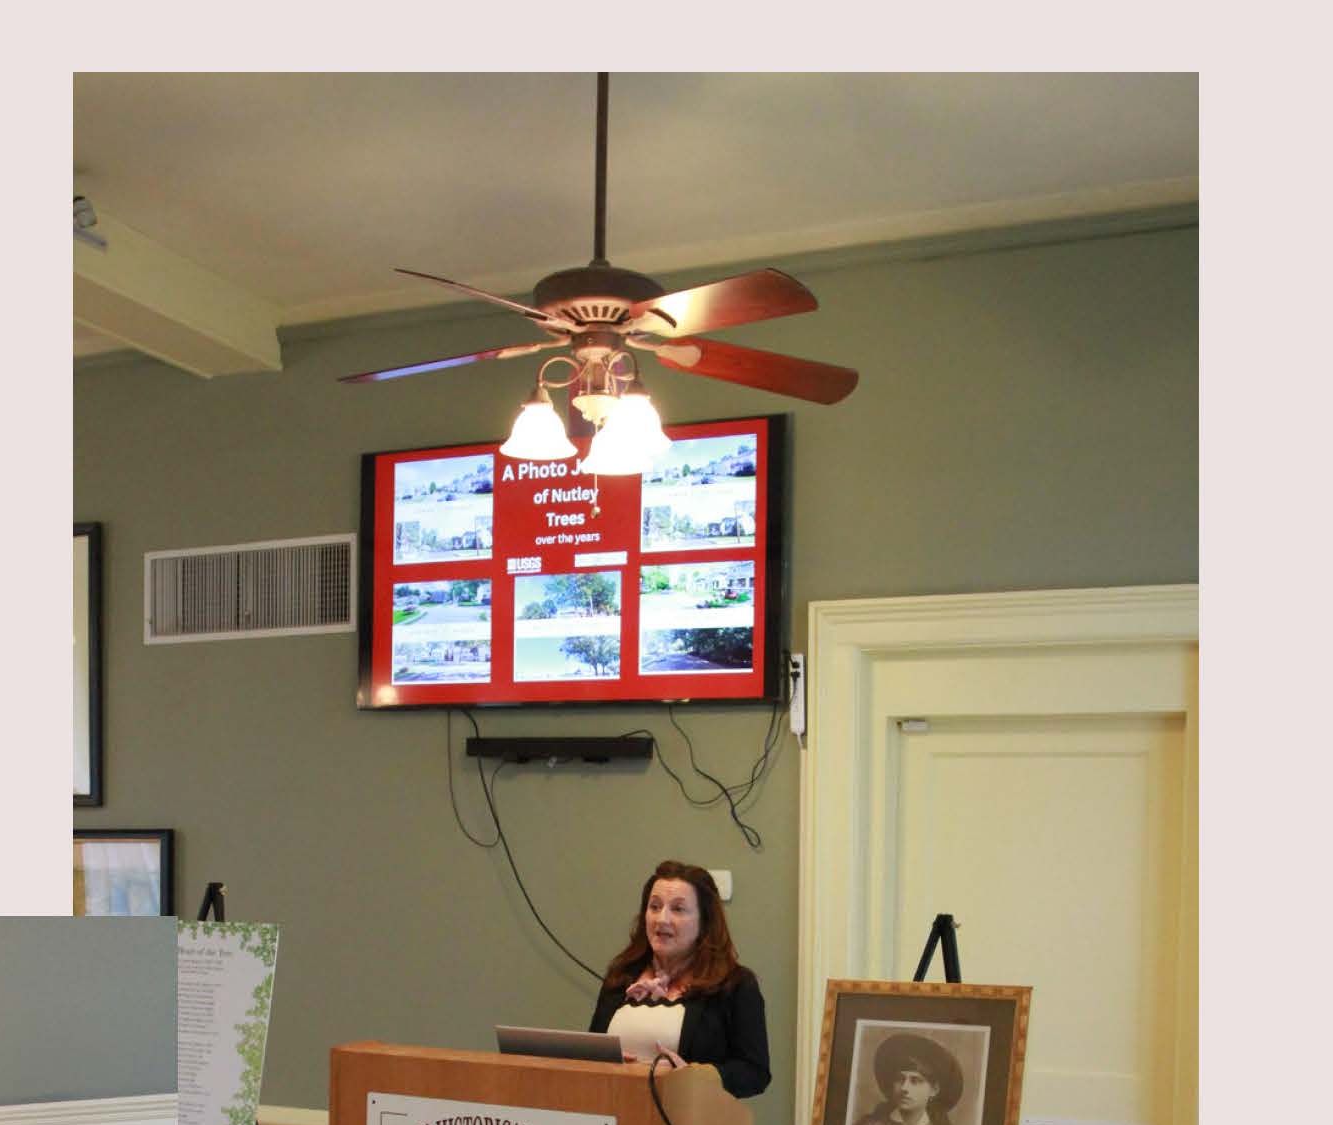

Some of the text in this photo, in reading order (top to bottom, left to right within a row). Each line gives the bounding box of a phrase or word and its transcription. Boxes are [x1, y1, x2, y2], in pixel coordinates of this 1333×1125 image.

[502, 464, 514, 481] A
[518, 462, 568, 480] Photo
[533, 486, 599, 504] of Nutley
[546, 512, 586, 527] Trees
[535, 533, 601, 546] over the years
